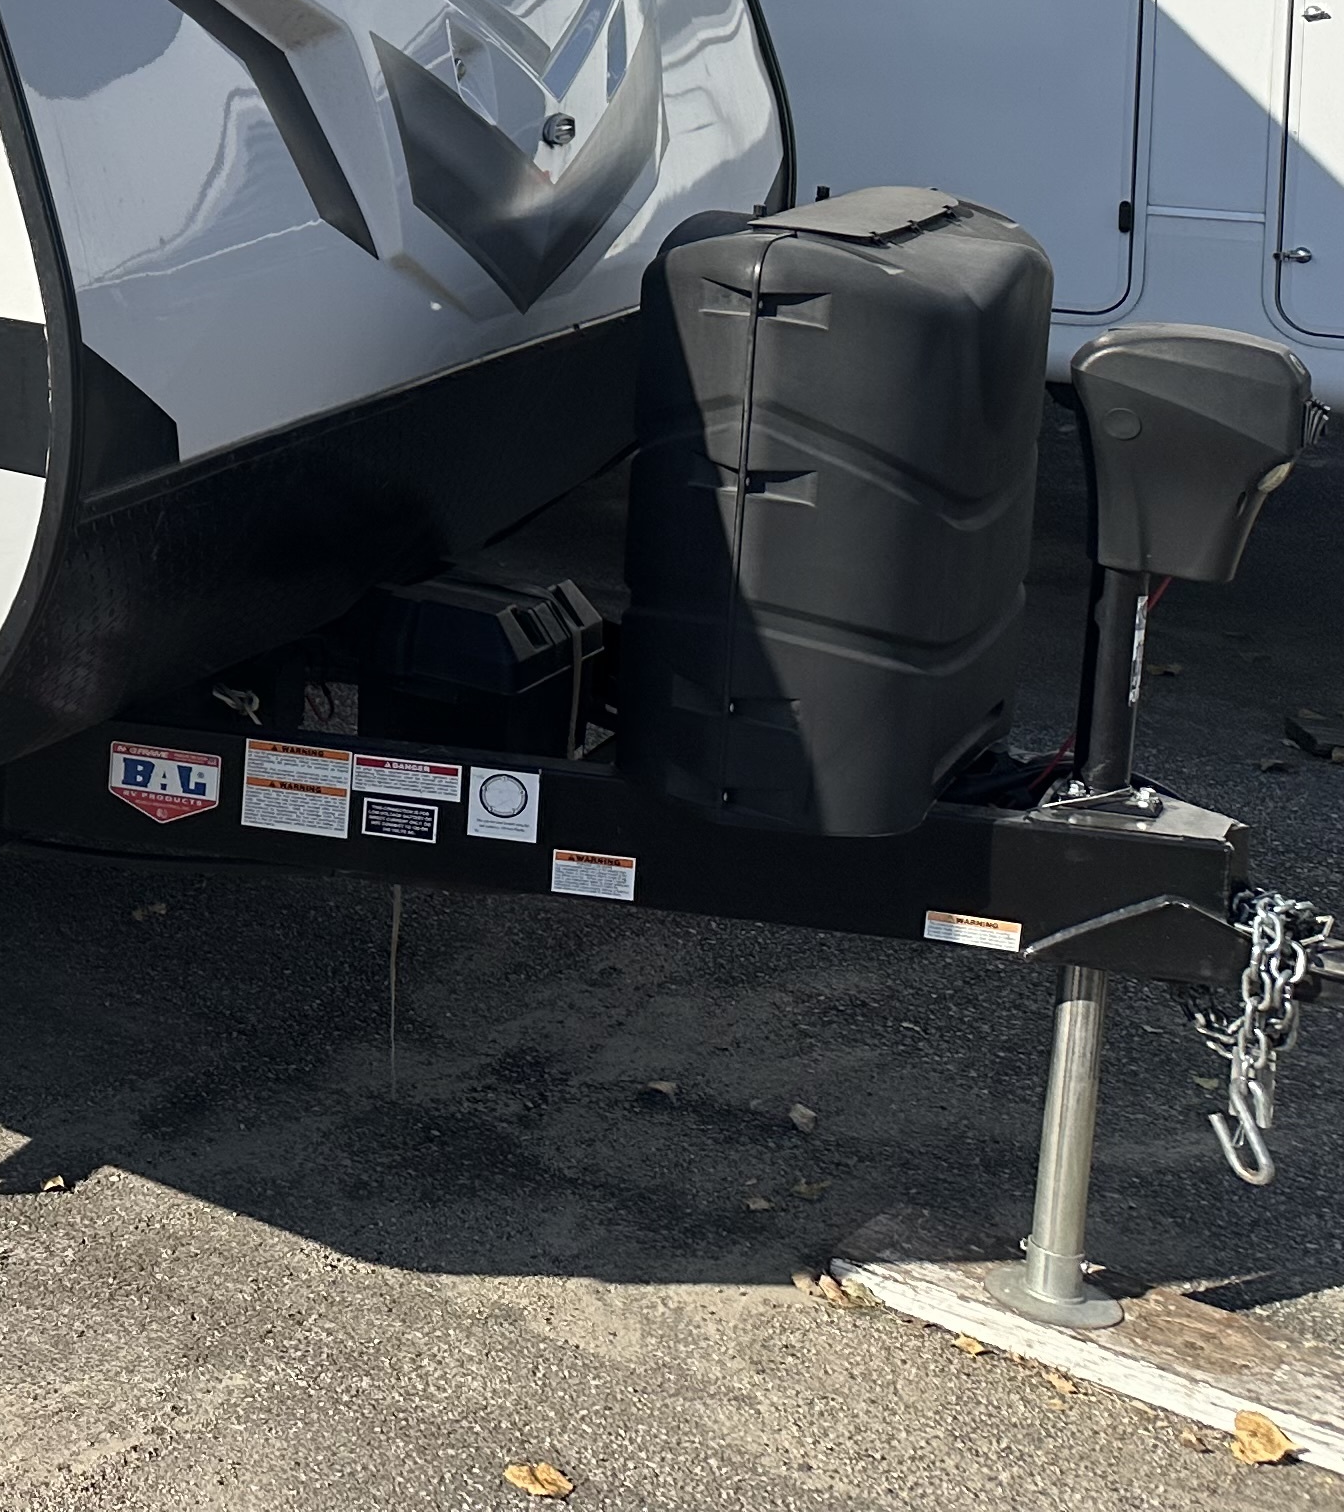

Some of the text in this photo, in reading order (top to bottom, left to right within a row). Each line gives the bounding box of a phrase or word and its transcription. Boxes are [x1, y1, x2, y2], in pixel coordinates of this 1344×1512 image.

[282, 745, 325, 757] WARNING
[391, 762, 431, 773] DANGER
[122, 757, 207, 796] BAL
[279, 781, 322, 793] WARNING
[141, 792, 203, 806] PRODUCTS
[576, 855, 621, 866] WARNING
[956, 917, 999, 929] WARNING
